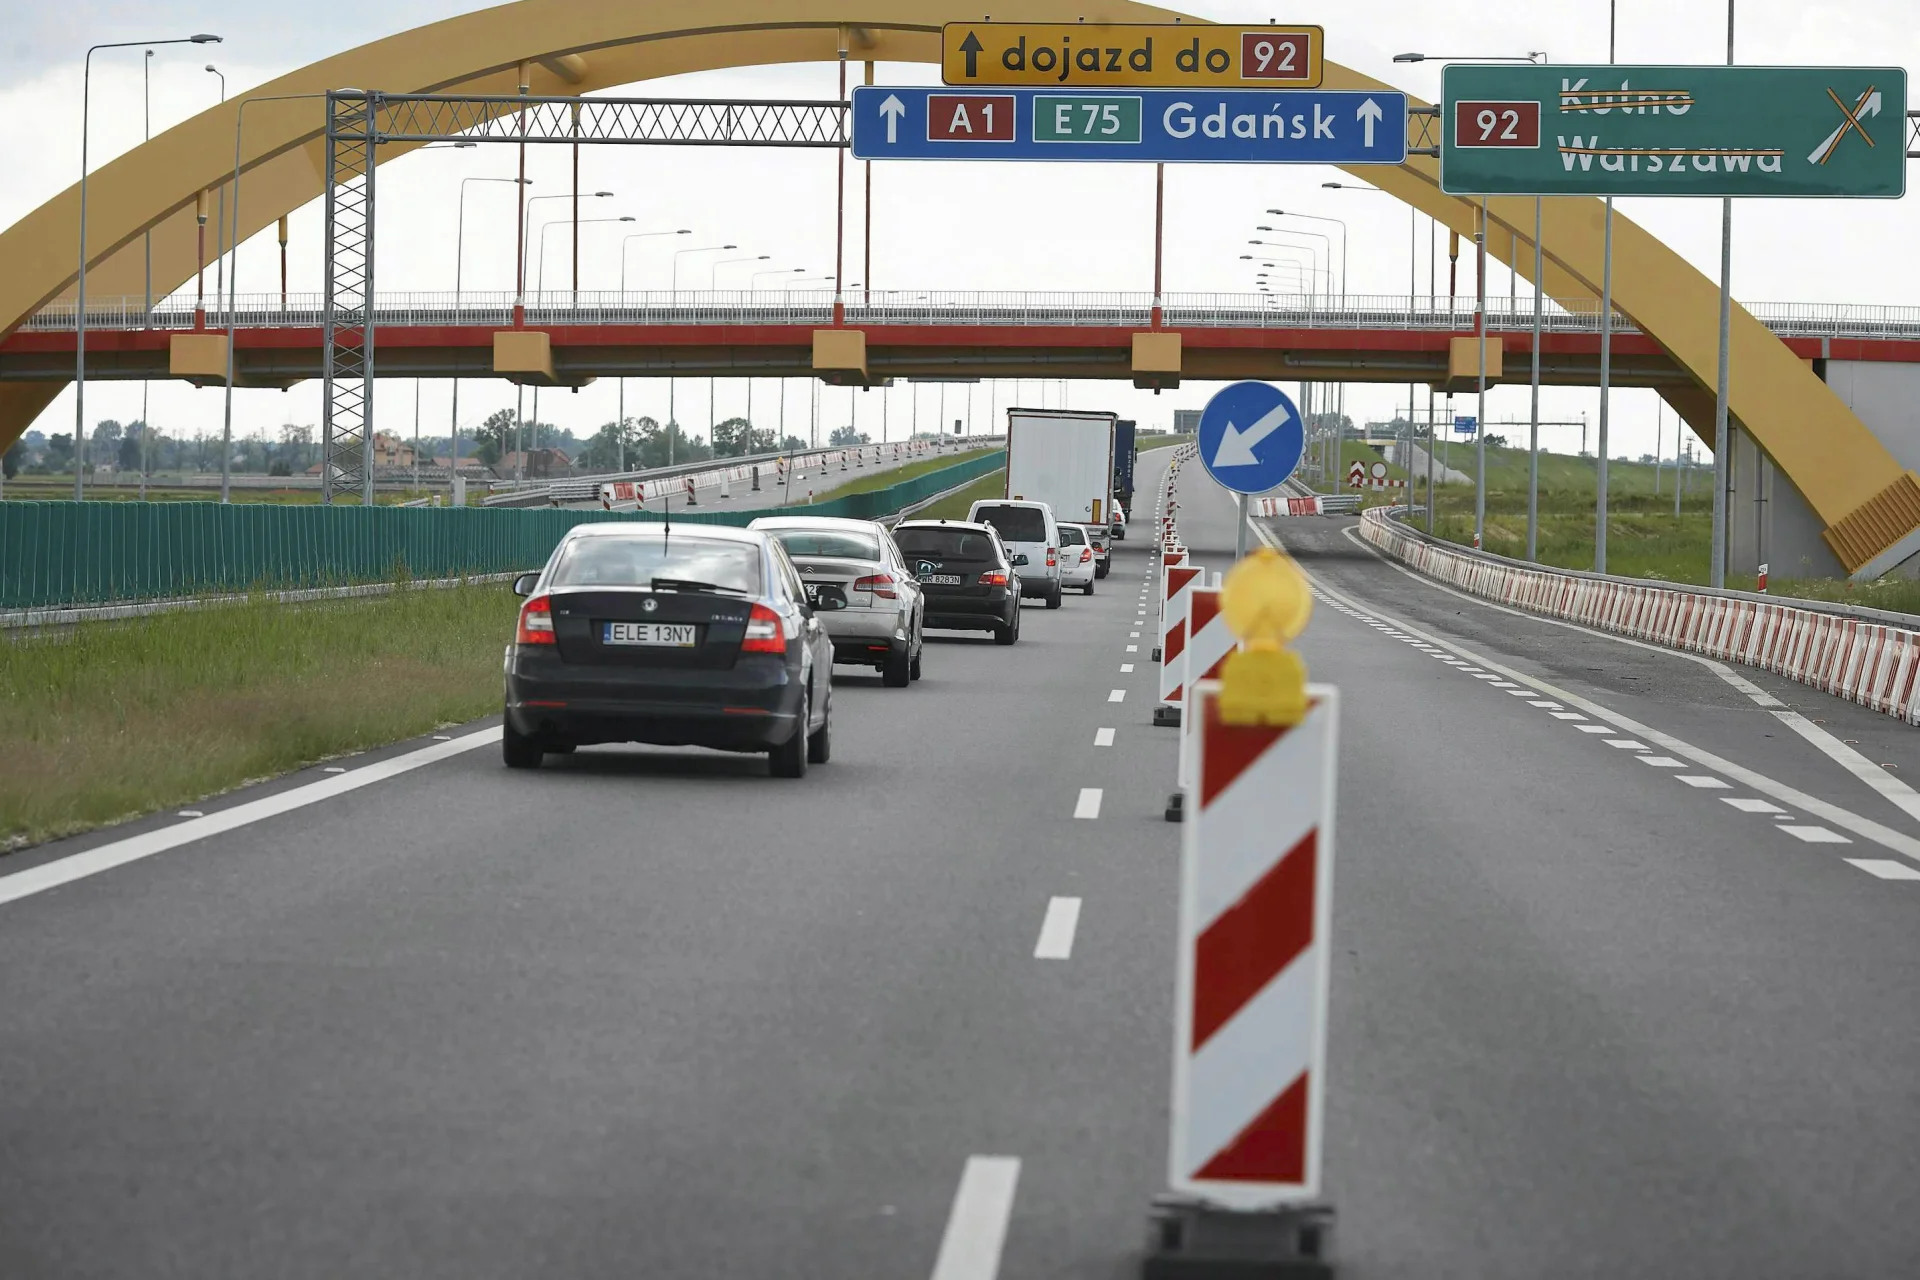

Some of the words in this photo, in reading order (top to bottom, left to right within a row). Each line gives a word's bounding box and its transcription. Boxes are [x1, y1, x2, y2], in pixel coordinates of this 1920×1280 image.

[1001, 35, 1153, 83] dojazd
[1175, 36, 1231, 74] do
[1254, 41, 1296, 72] 92
[1163, 102, 1335, 139] Gdańsk
[1476, 109, 1519, 141] 92
[1557, 135, 1783, 172] Warszawa
[613, 624, 648, 641] ELE
[655, 625, 693, 643] 13NY
